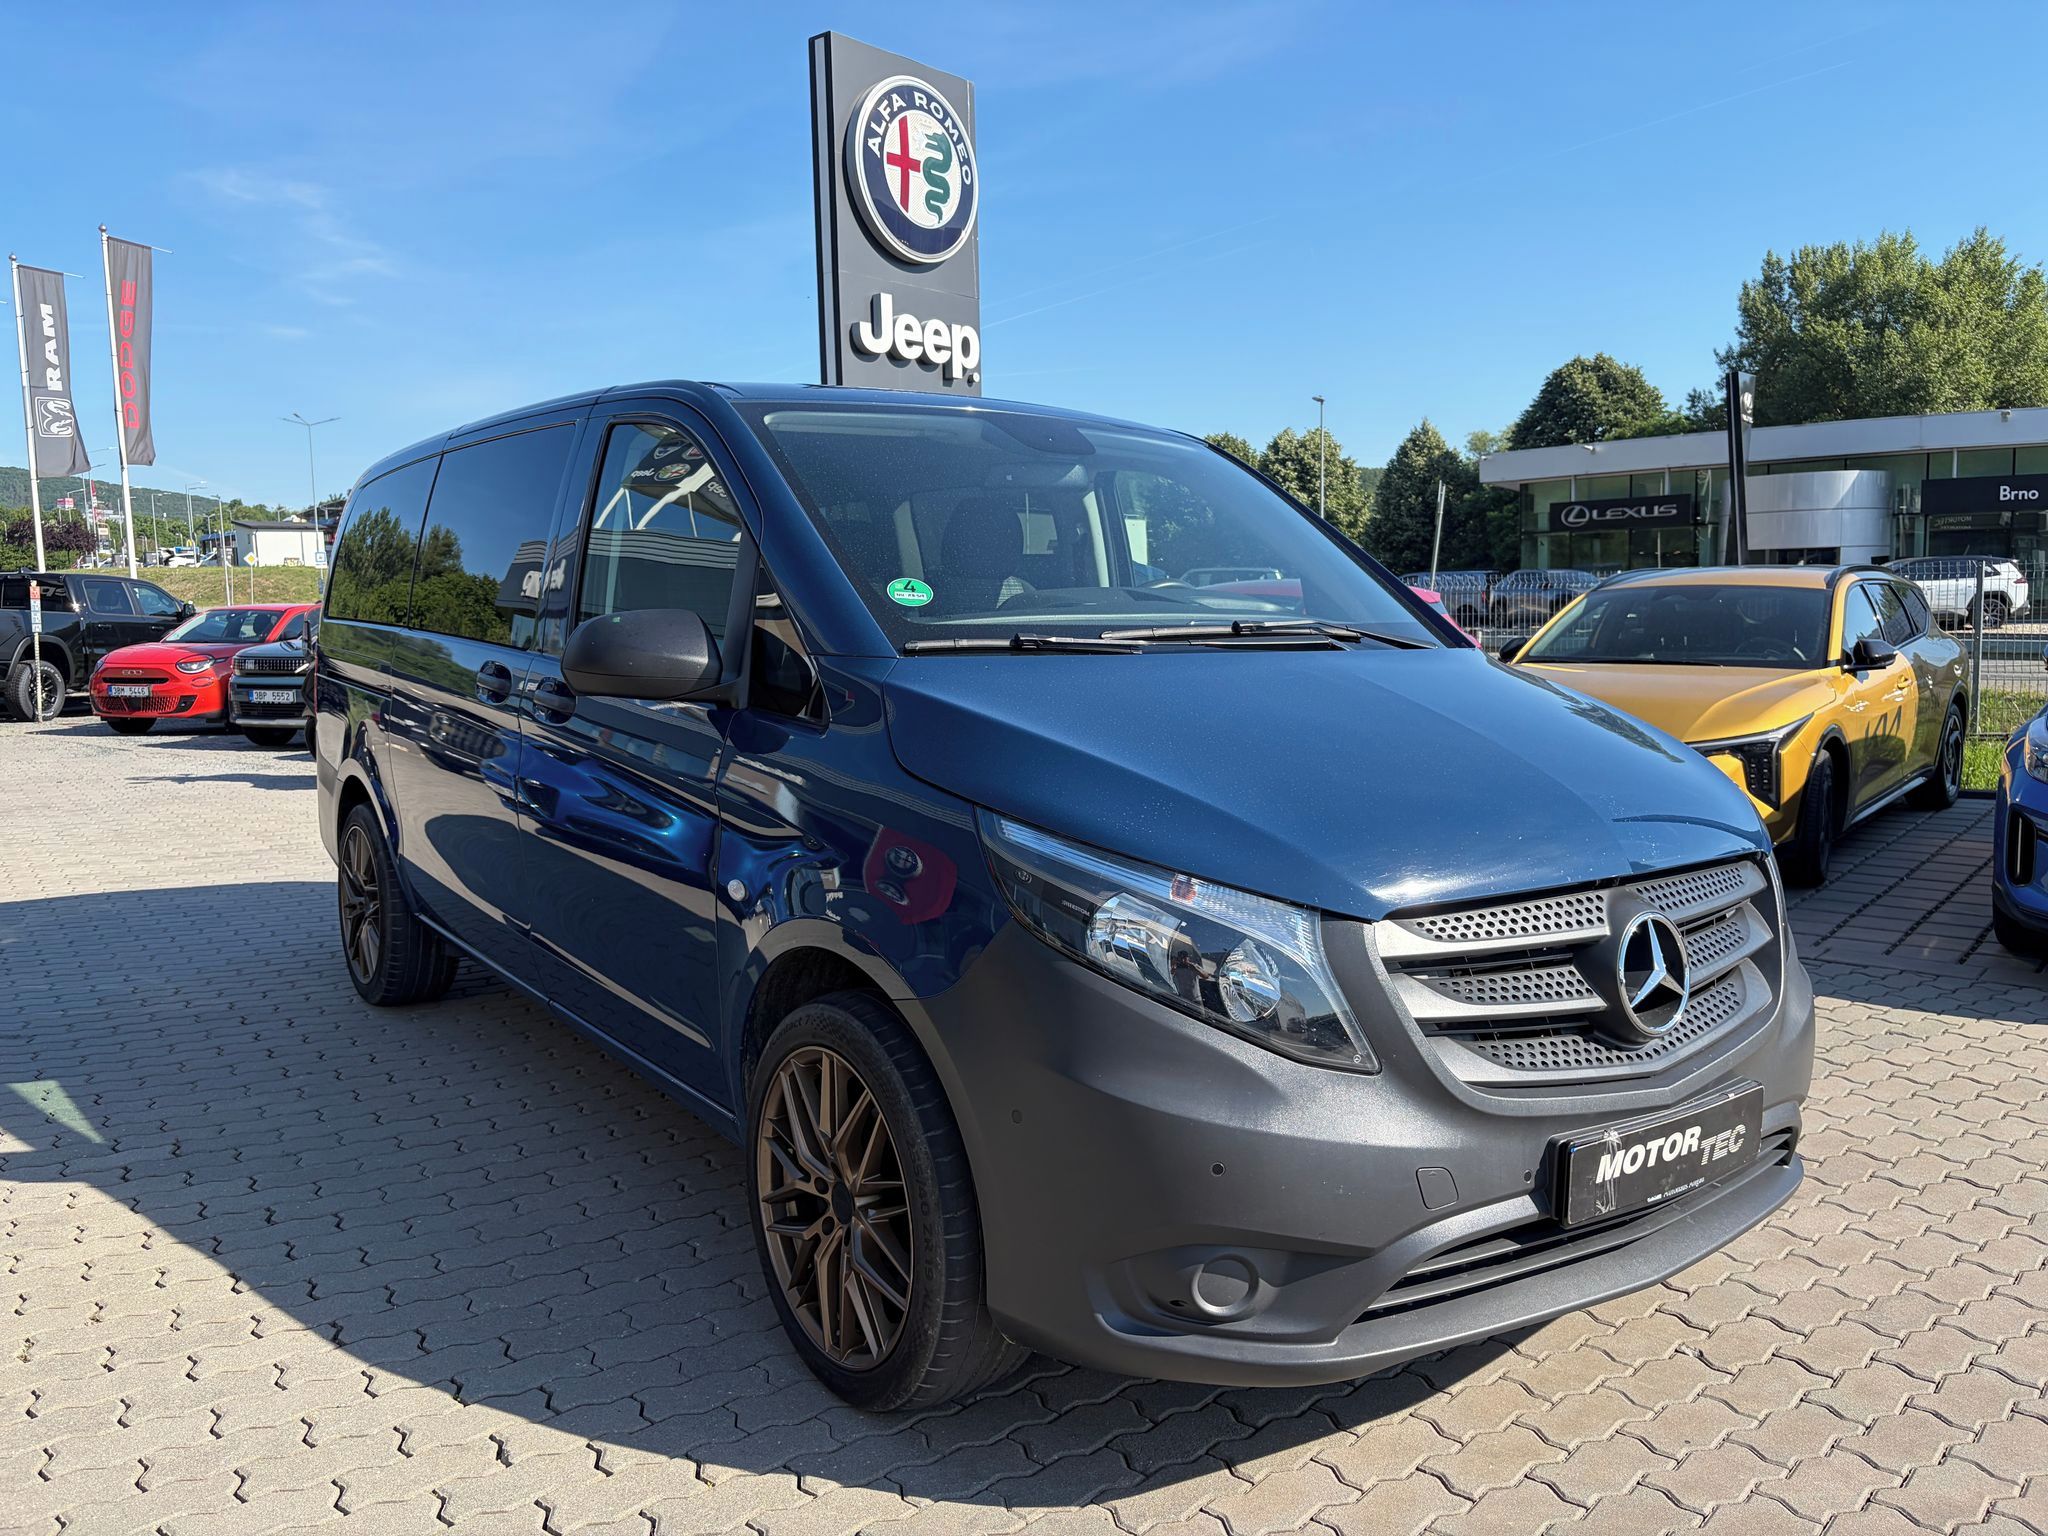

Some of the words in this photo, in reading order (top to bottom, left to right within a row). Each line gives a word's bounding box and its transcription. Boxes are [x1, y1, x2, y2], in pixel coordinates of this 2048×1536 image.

[867, 92, 907, 158] ALFA
[913, 91, 972, 186] ROMEO
[40, 303, 63, 391] RAM
[119, 280, 140, 429] DODGE
[2000, 485, 2039, 501] Brno
[1592, 504, 1678, 520] LEXUS
[904, 580, 916, 592] 4
[272, 691, 290, 701] 5552
